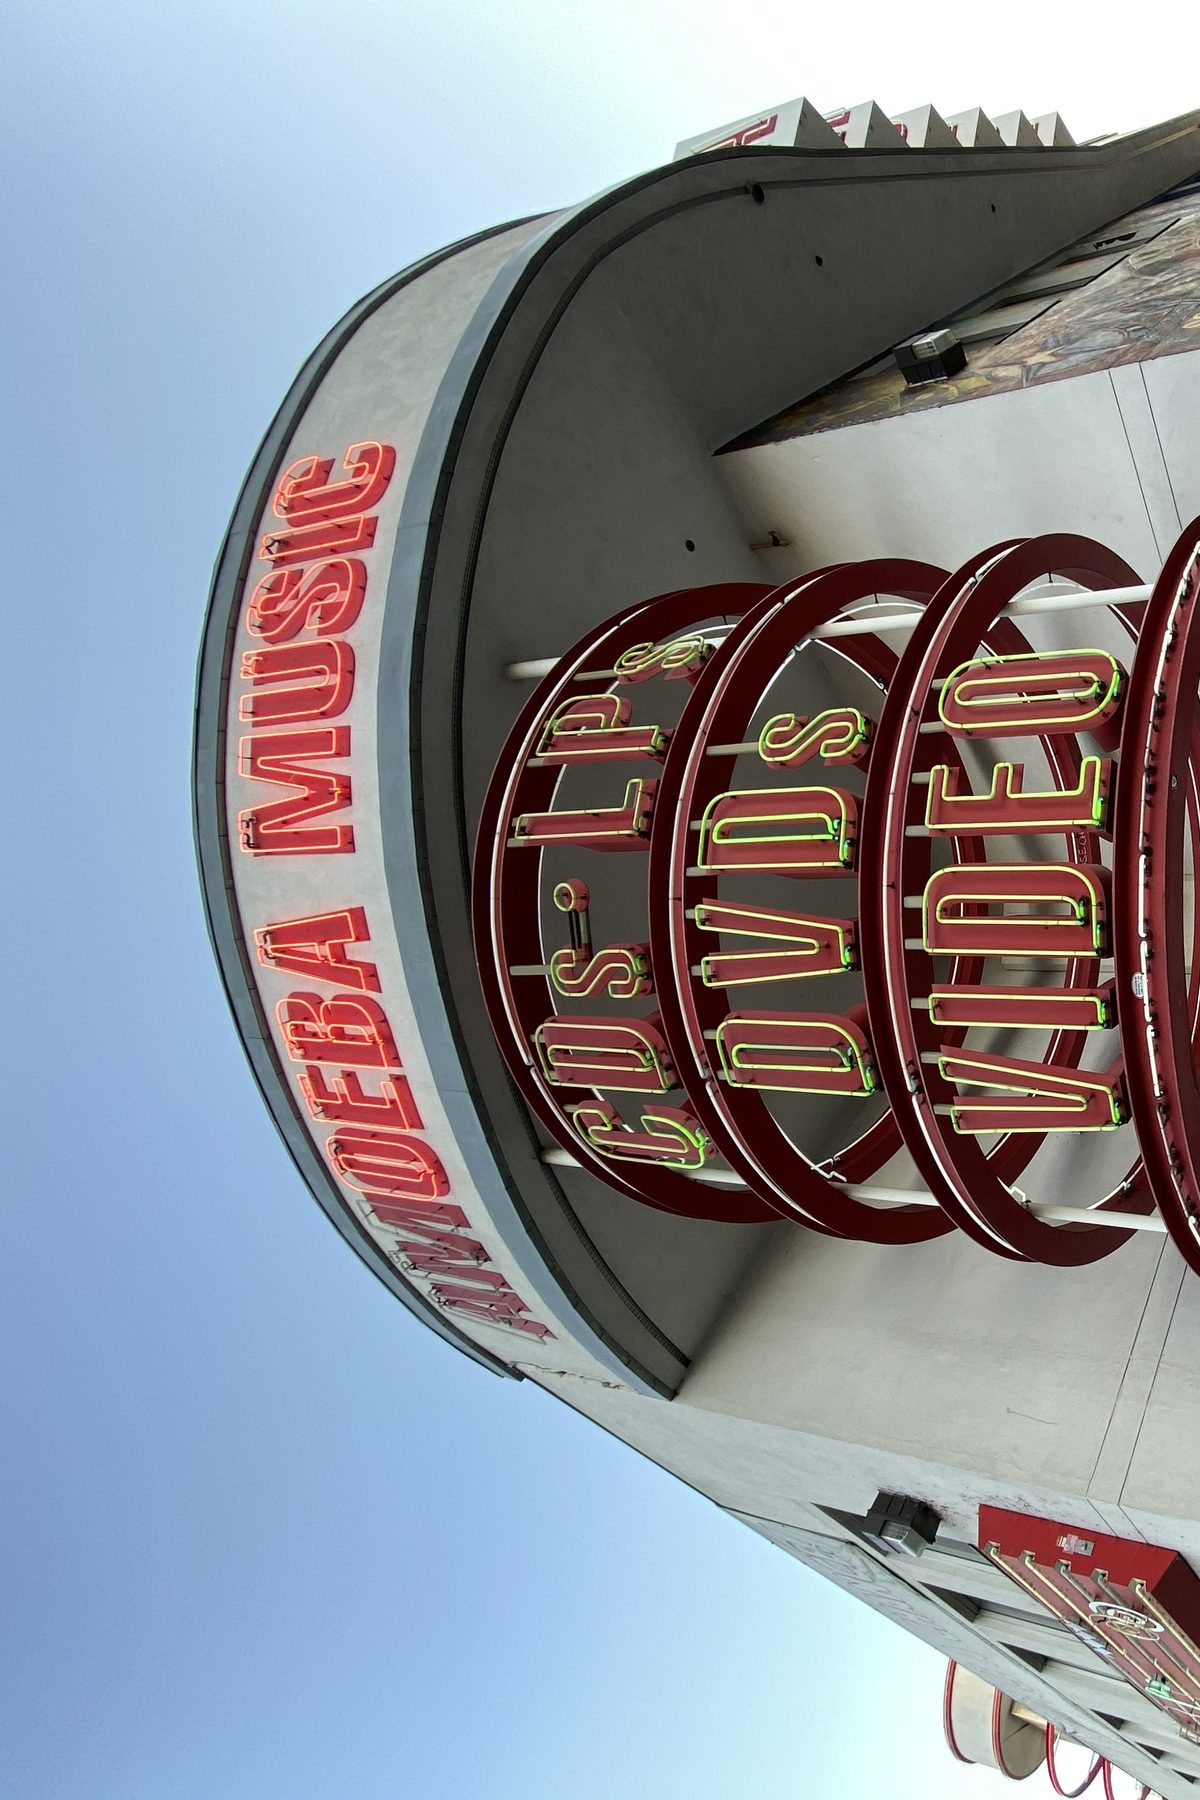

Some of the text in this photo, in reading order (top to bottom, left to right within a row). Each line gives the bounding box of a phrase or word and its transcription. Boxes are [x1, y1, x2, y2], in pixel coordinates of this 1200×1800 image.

[238, 440, 557, 1344] AMOEBA MUSIC
[511, 634, 716, 1168] CDs LPs
[694, 707, 880, 1097] DVDs
[922, 649, 1126, 1135] VIDEO
